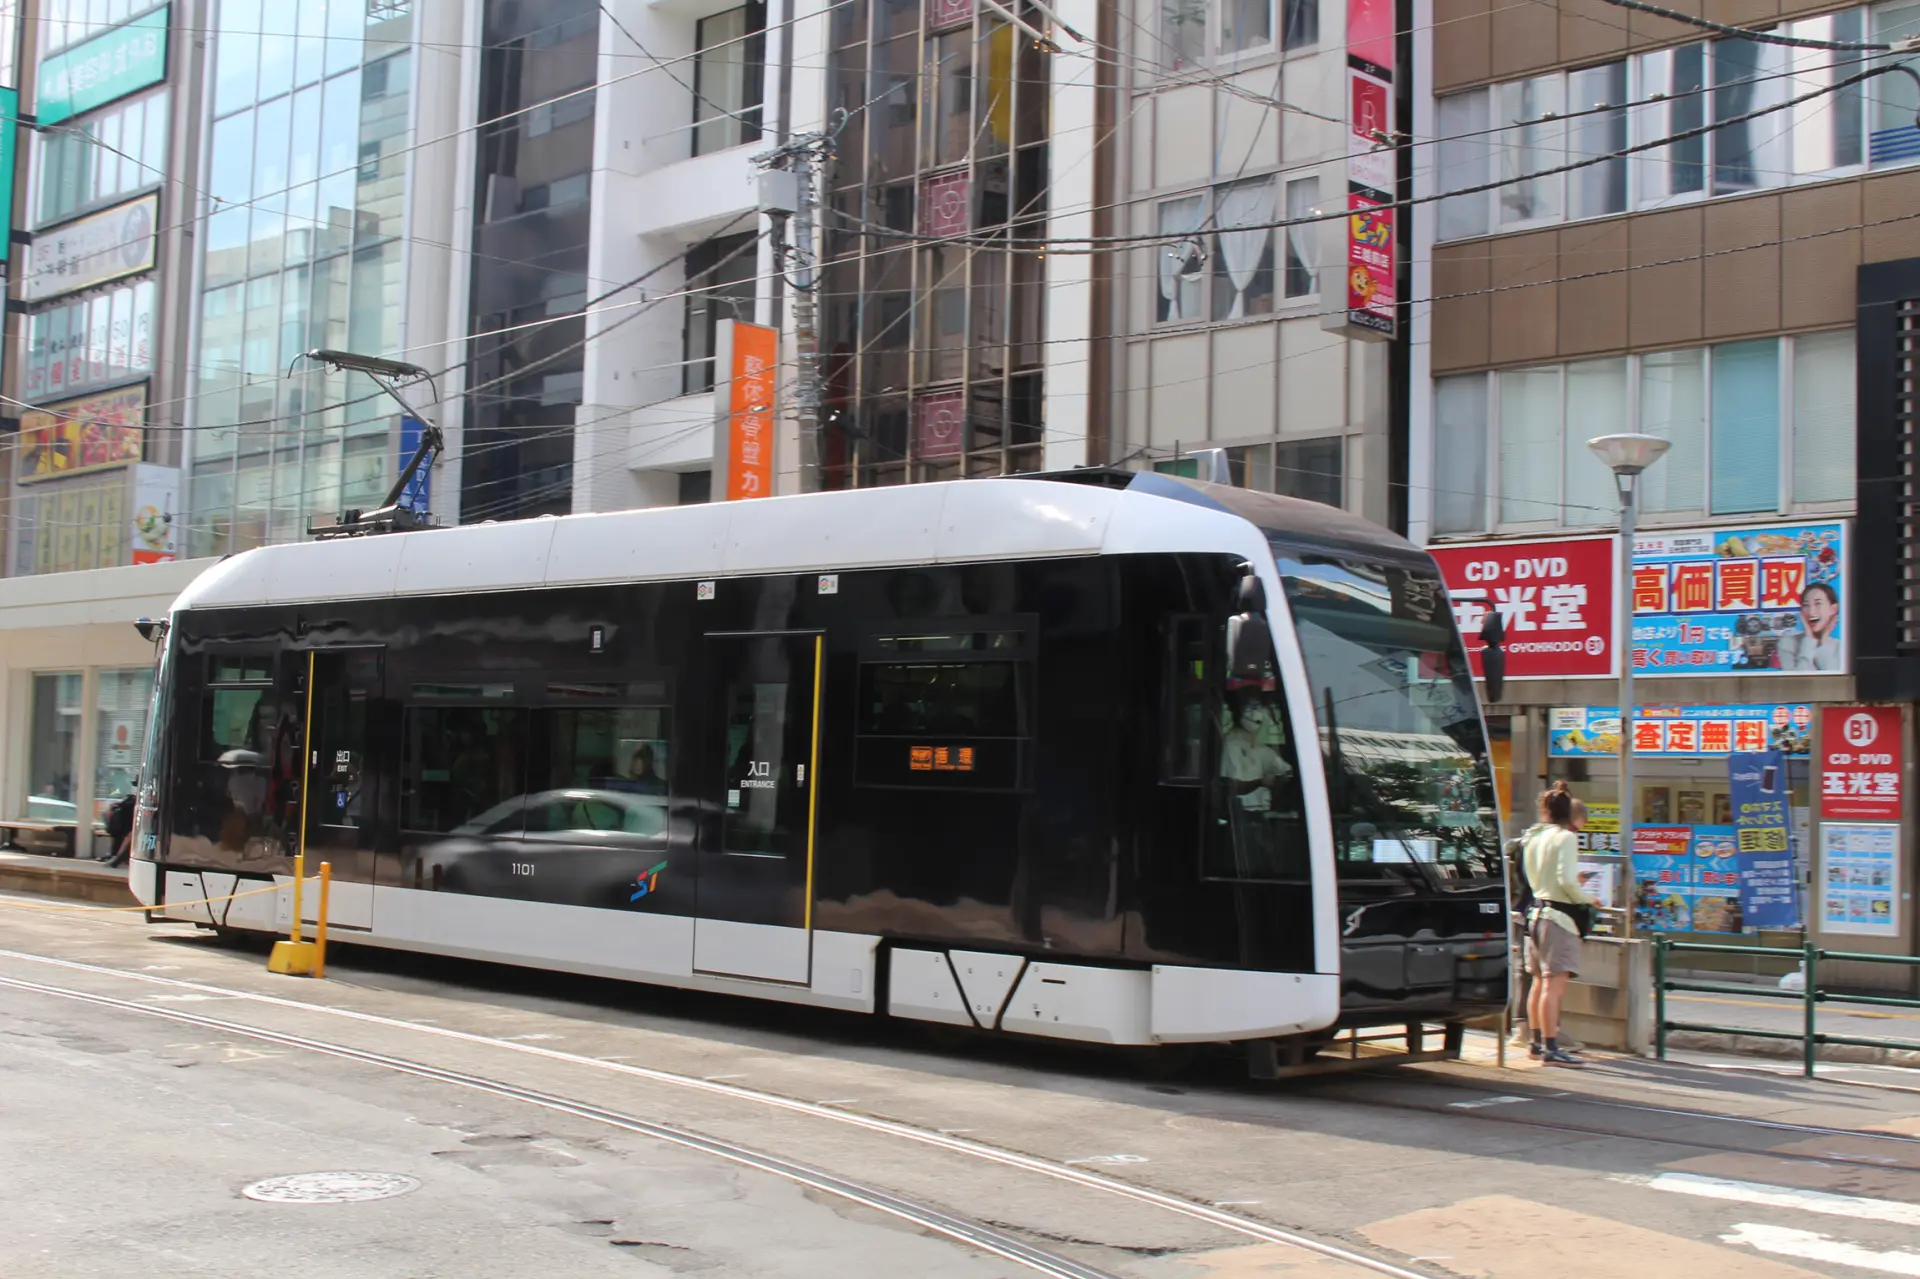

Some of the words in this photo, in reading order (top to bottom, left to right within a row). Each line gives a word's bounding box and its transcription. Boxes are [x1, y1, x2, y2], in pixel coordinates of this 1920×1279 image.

[1632, 561, 1805, 611] 高価買取
[1635, 721, 1766, 750] 査定無料
[1850, 719, 1872, 740] B1
[336, 750, 350, 763] 出口
[337, 764, 348, 773] EXIT
[747, 761, 770, 777] 入口
[740, 779, 776, 789] ENTRANCE
[1822, 771, 1899, 795] 玉光堂
[512, 862, 535, 876] 1101
